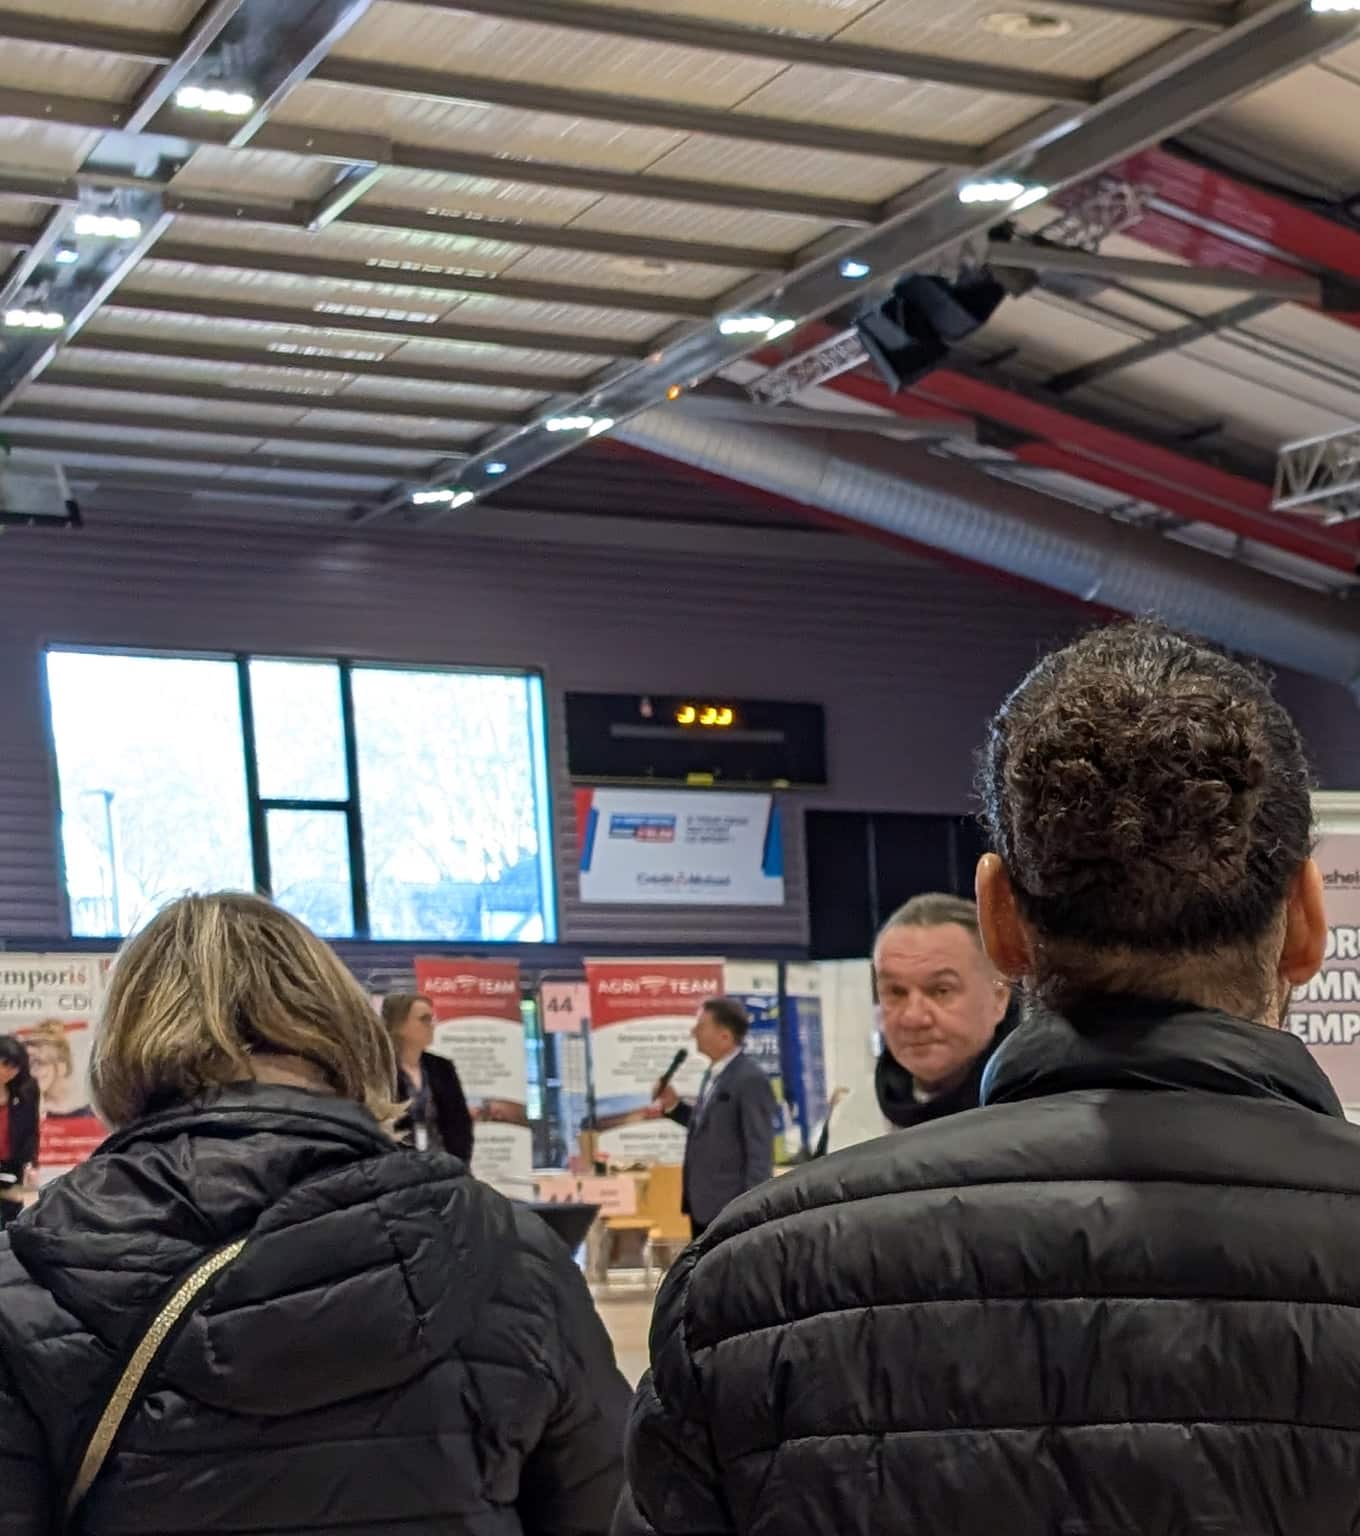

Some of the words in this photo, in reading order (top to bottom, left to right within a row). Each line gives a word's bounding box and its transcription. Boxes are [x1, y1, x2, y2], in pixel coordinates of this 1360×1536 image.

[424, 977, 457, 993] AGRI
[477, 978, 516, 994] TEAM
[598, 979, 640, 994] AGRI
[670, 979, 718, 994] TEAM
[547, 996, 573, 1014] 44
